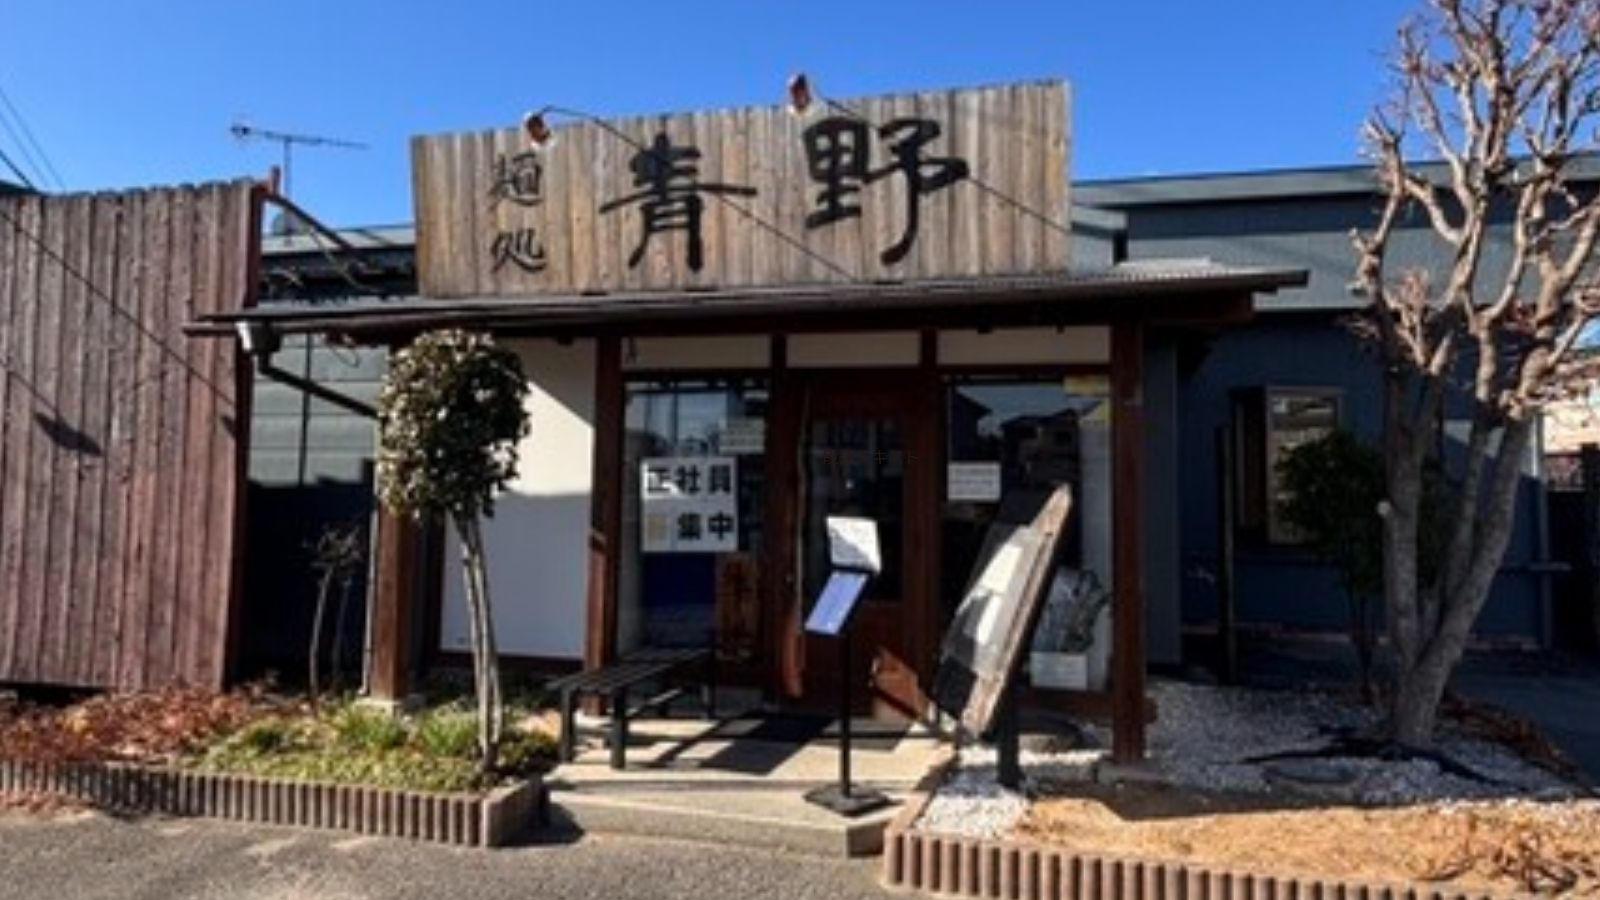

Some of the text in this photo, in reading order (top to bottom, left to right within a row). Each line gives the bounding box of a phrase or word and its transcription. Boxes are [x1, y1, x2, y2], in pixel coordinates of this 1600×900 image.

[599, 118, 969, 273] 青野
[648, 464, 731, 495] 正社員
[648, 510, 734, 541] 集中
